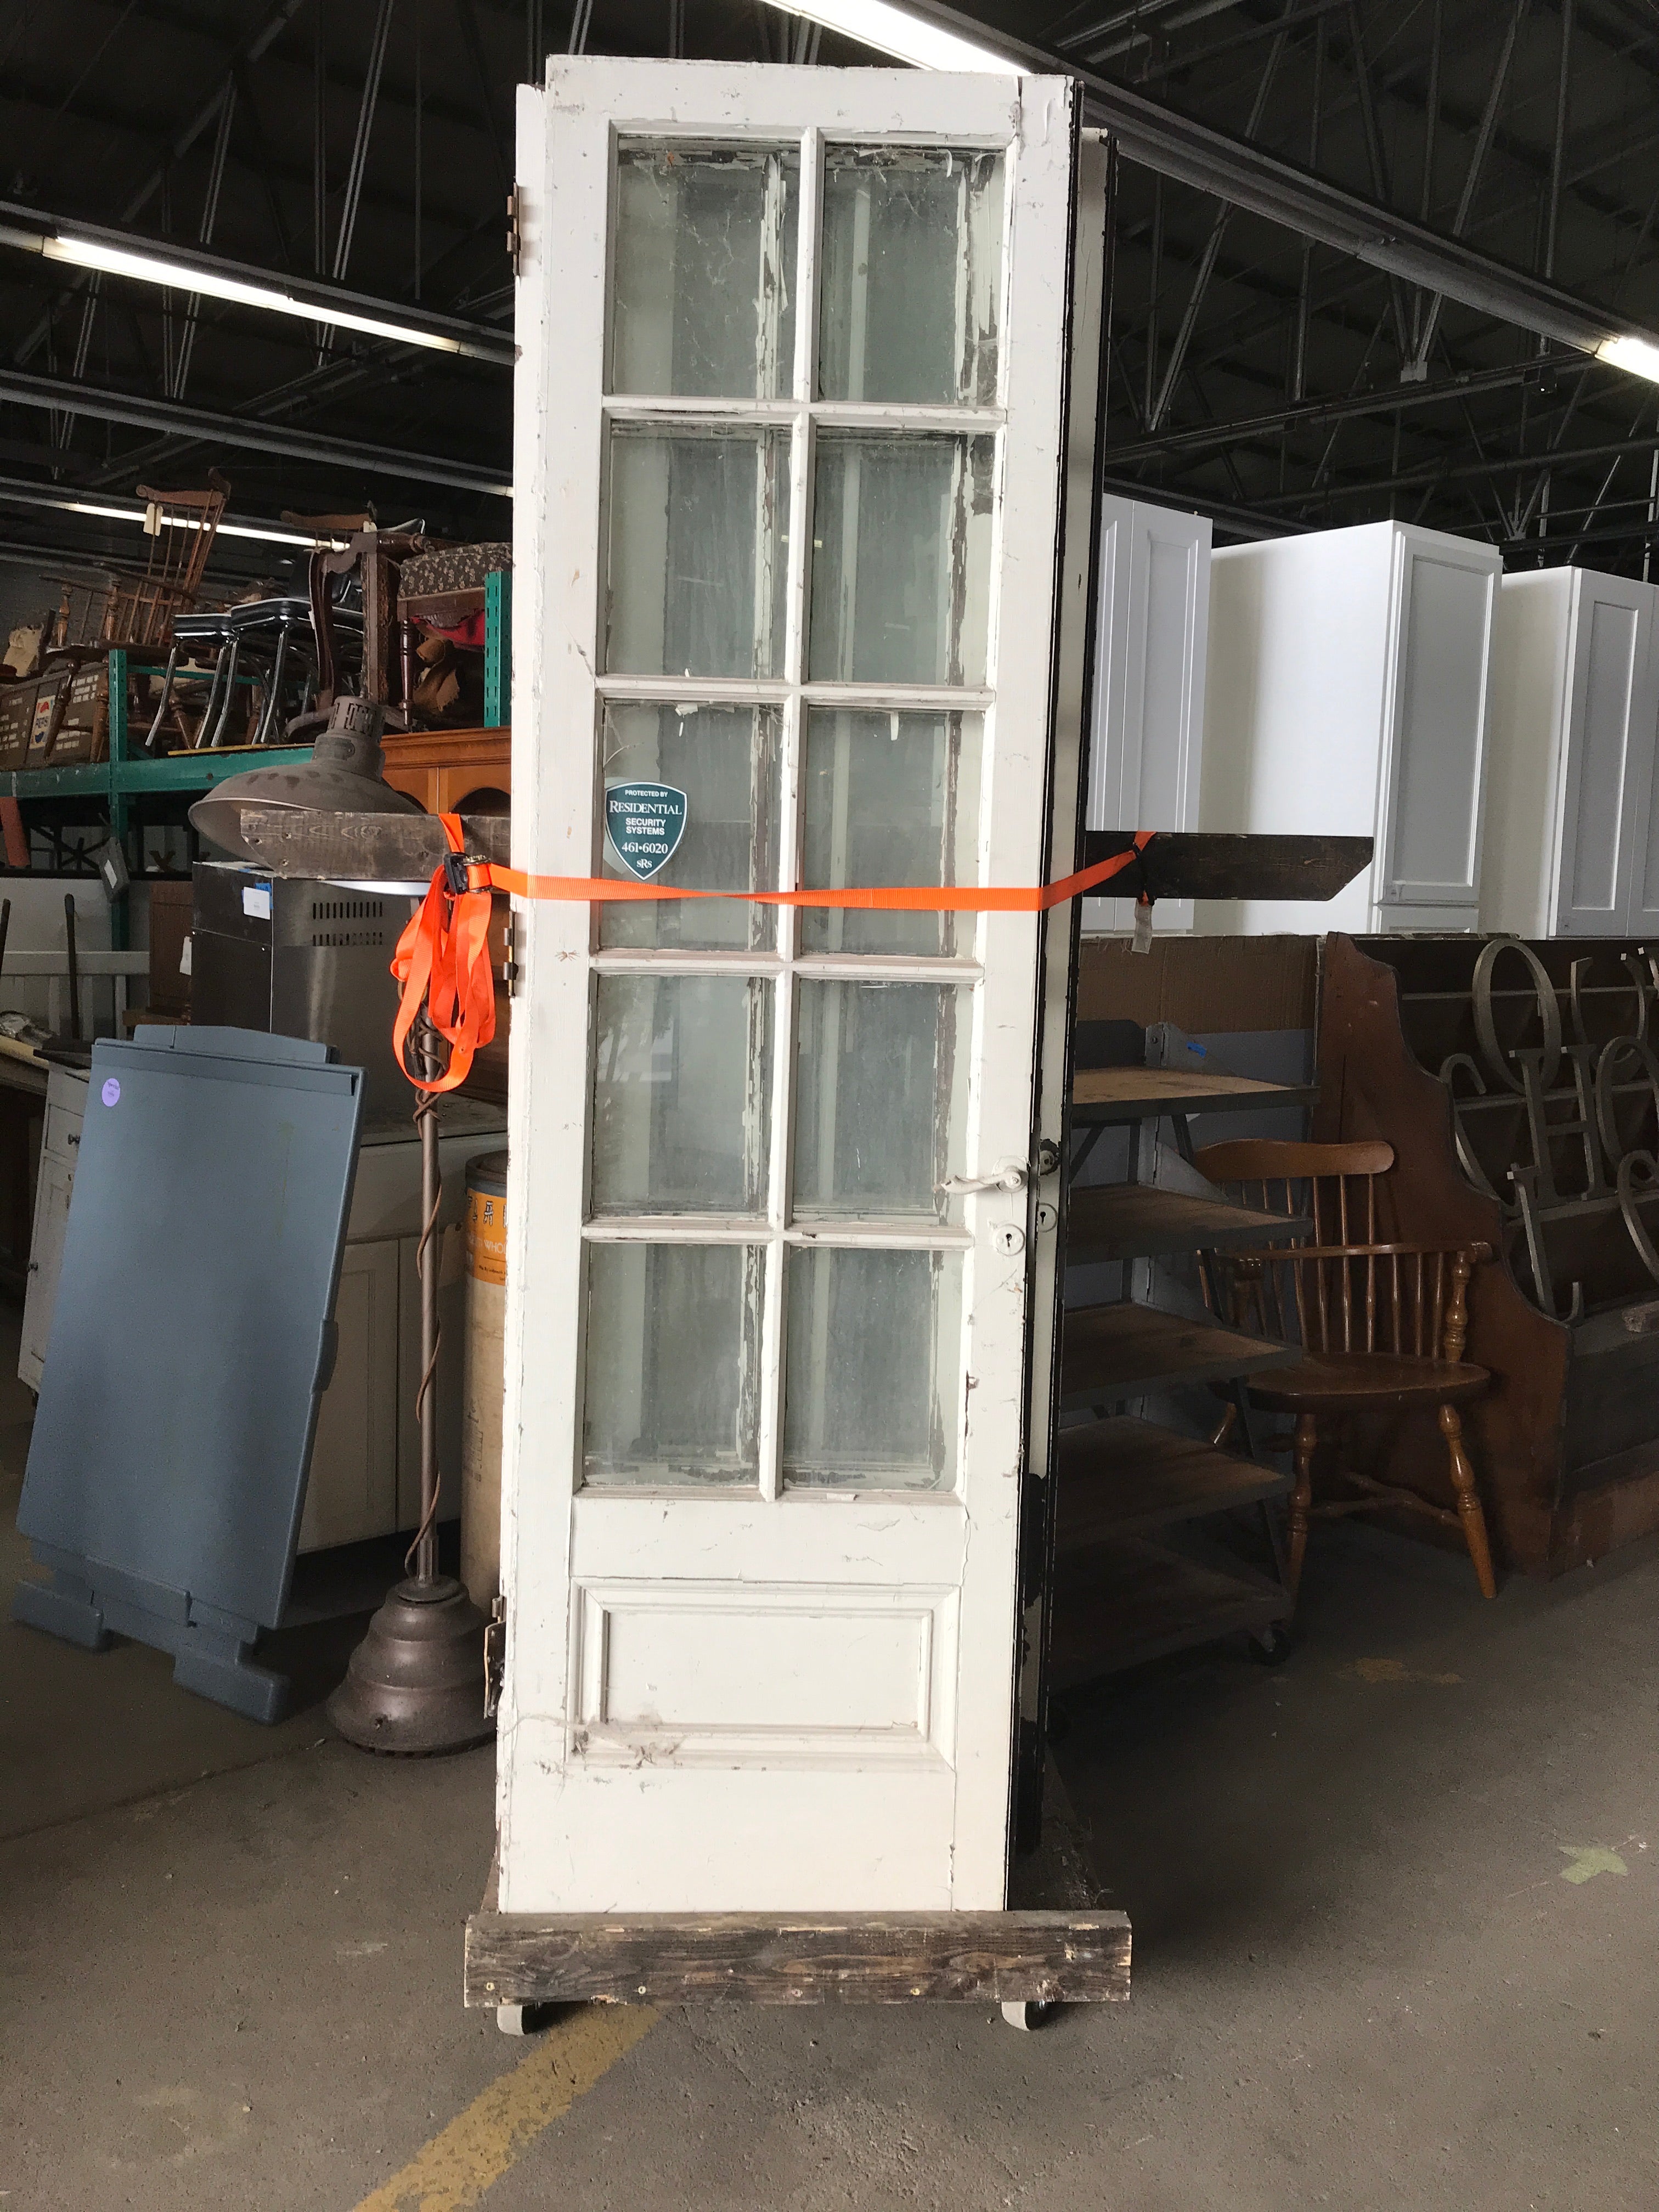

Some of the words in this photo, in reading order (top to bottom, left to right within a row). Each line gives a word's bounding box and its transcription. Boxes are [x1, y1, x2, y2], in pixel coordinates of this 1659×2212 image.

[610, 800, 682, 815] RESIDENTIAL
[625, 817, 667, 827] SECURITY
[626, 826, 665, 836] SYSTEMS
